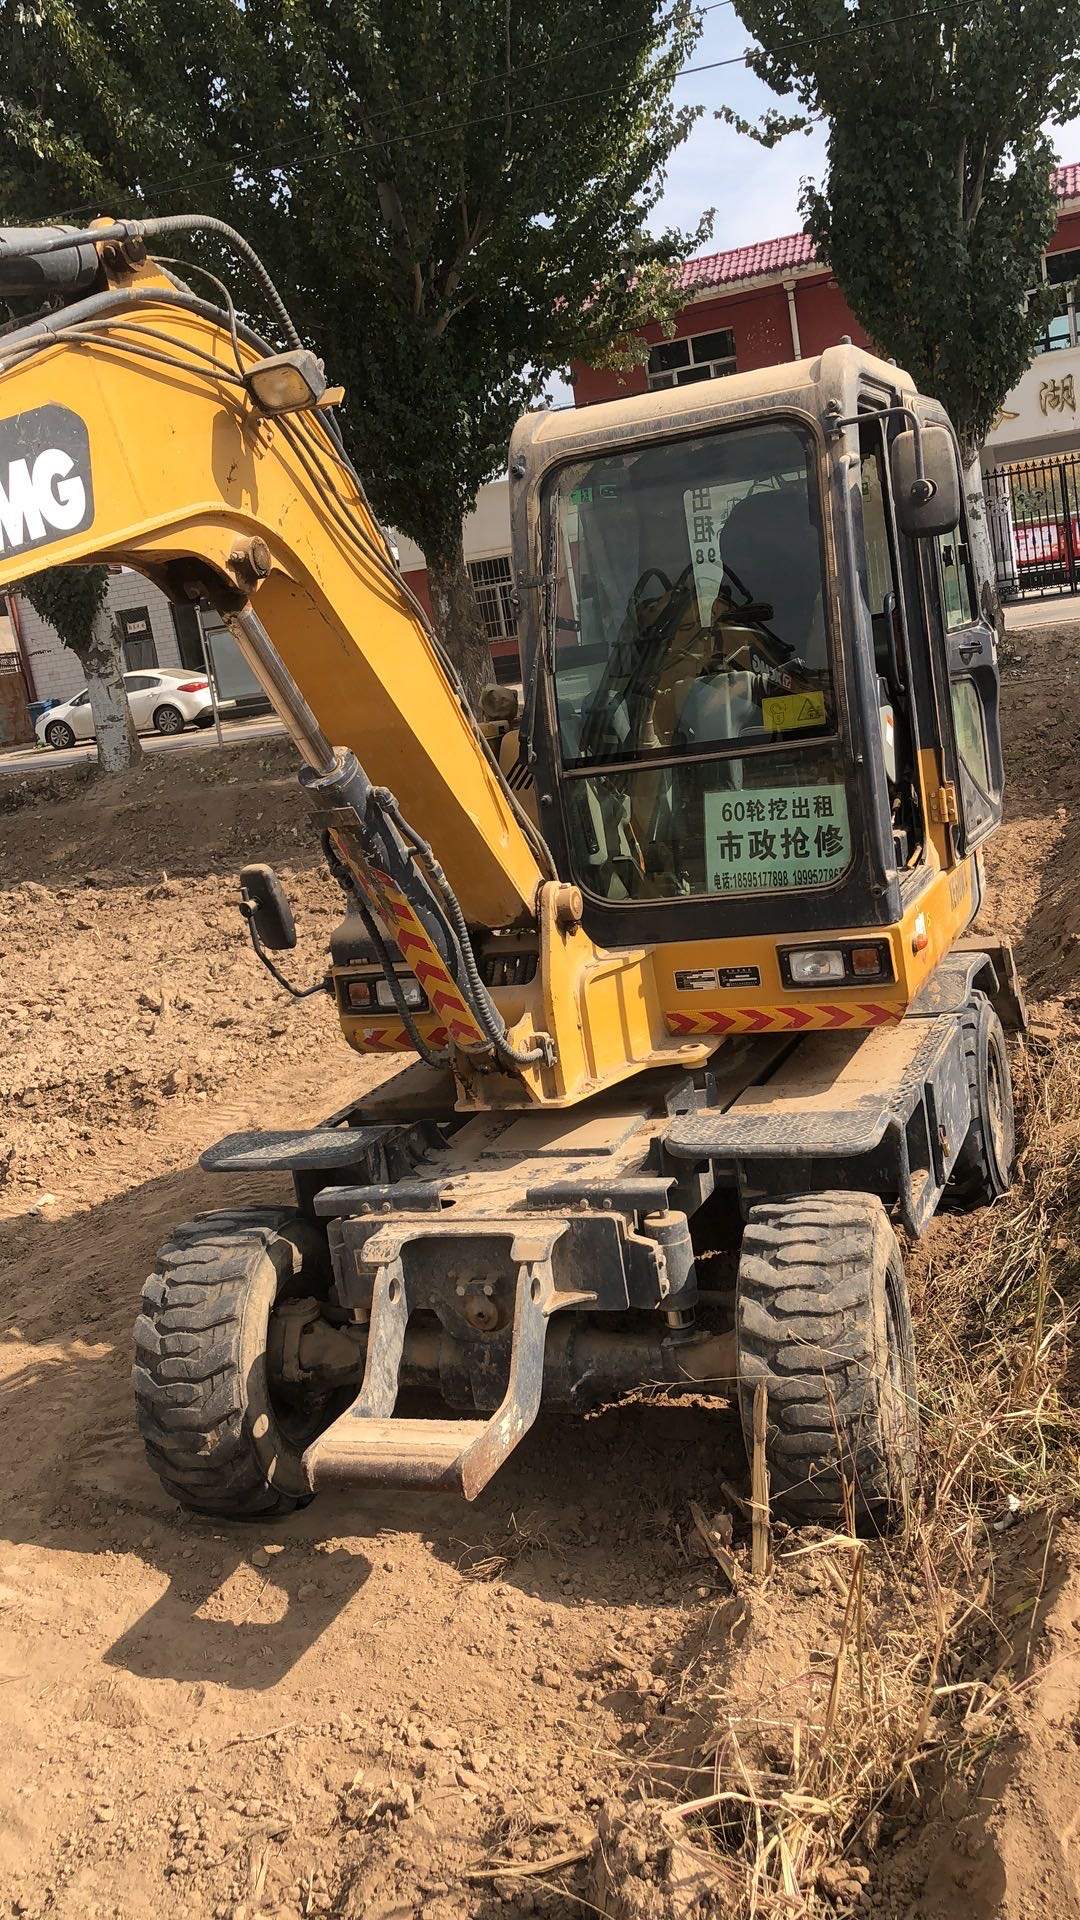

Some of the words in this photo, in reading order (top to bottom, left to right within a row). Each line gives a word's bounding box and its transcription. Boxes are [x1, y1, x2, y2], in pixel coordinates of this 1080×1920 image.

[722, 795, 834, 822] 60轮挖出租
[717, 824, 844, 862] 市政抢修
